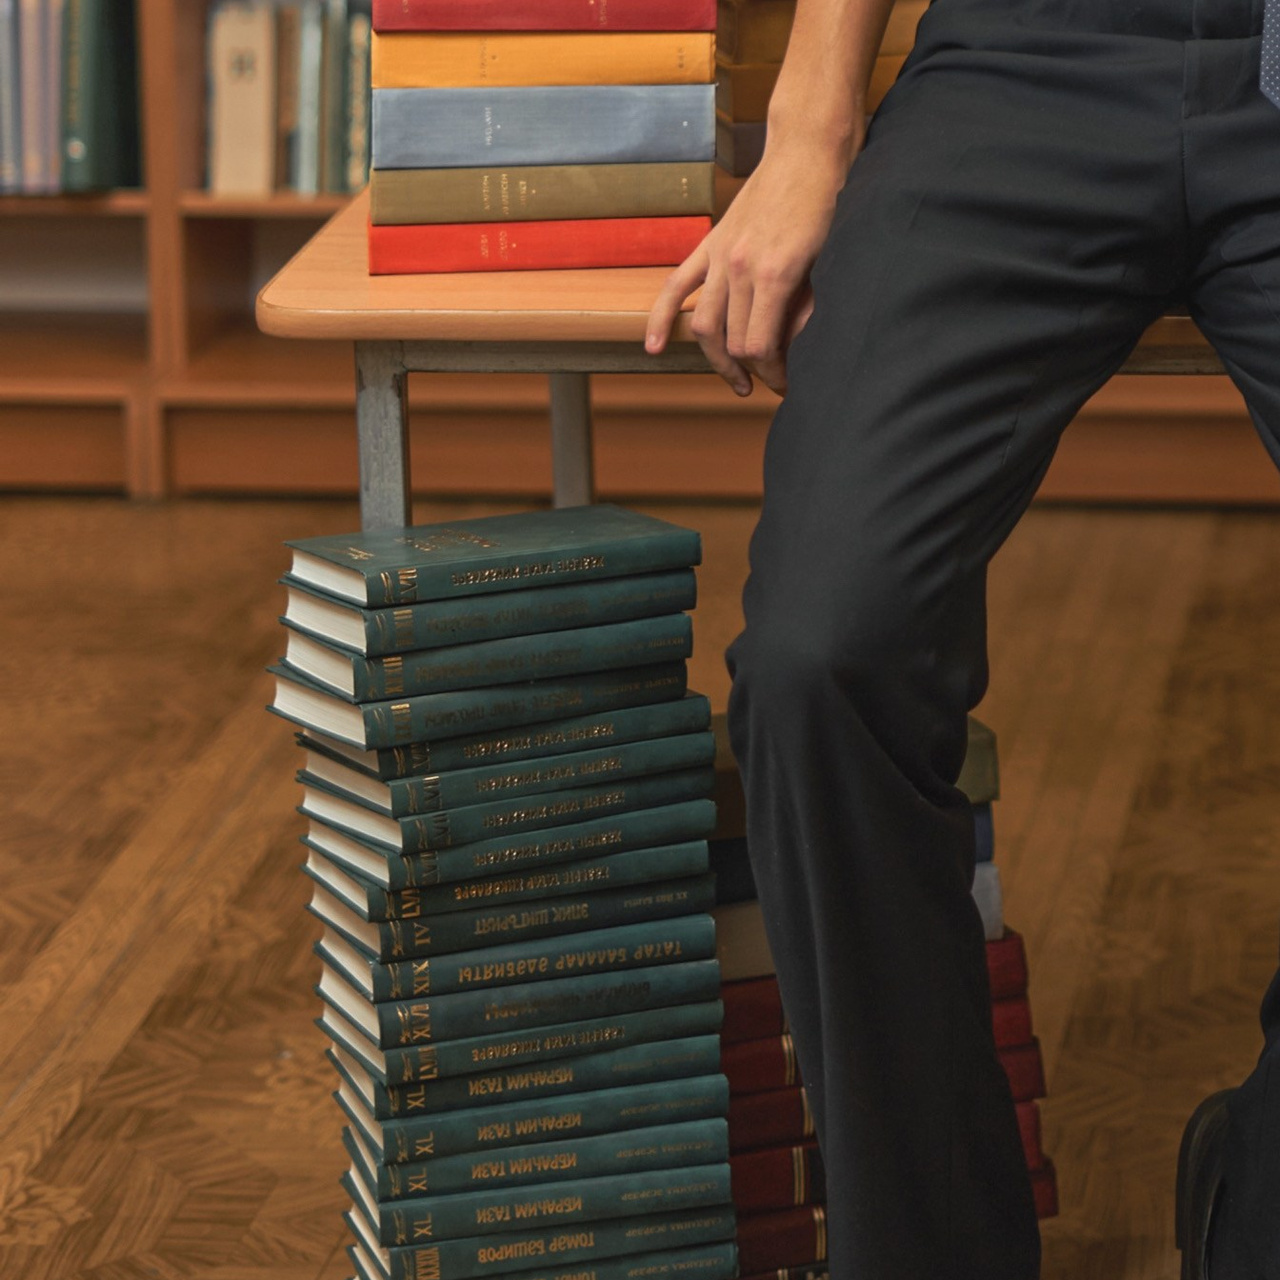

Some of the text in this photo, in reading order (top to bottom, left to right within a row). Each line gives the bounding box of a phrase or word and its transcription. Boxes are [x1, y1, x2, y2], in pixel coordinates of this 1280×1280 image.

[413, 922, 432, 946] IV
[457, 941, 682, 983] ТАТАР БАЛАЛАР ӘДӘБИЯТЫ
[406, 1085, 425, 1110] XL
[414, 1131, 434, 1156] XL
[408, 1168, 428, 1193] XL
[413, 1212, 433, 1238] XL
